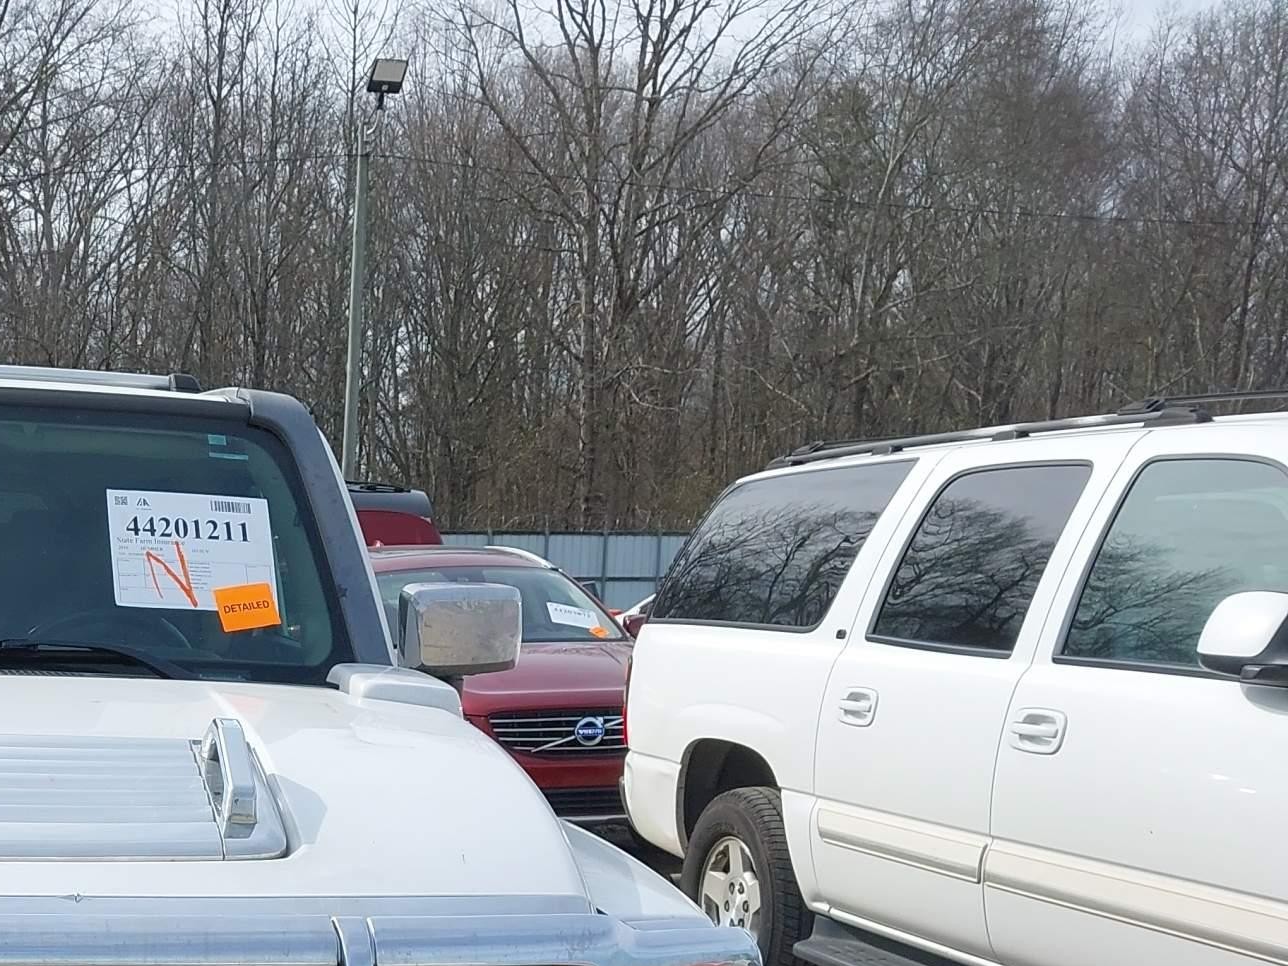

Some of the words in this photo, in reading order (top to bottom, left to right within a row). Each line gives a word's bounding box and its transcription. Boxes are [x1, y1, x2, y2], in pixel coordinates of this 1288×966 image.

[126, 515, 251, 543] 44201211
[135, 537, 153, 545] Farm
[223, 600, 270, 615] DETAILED
